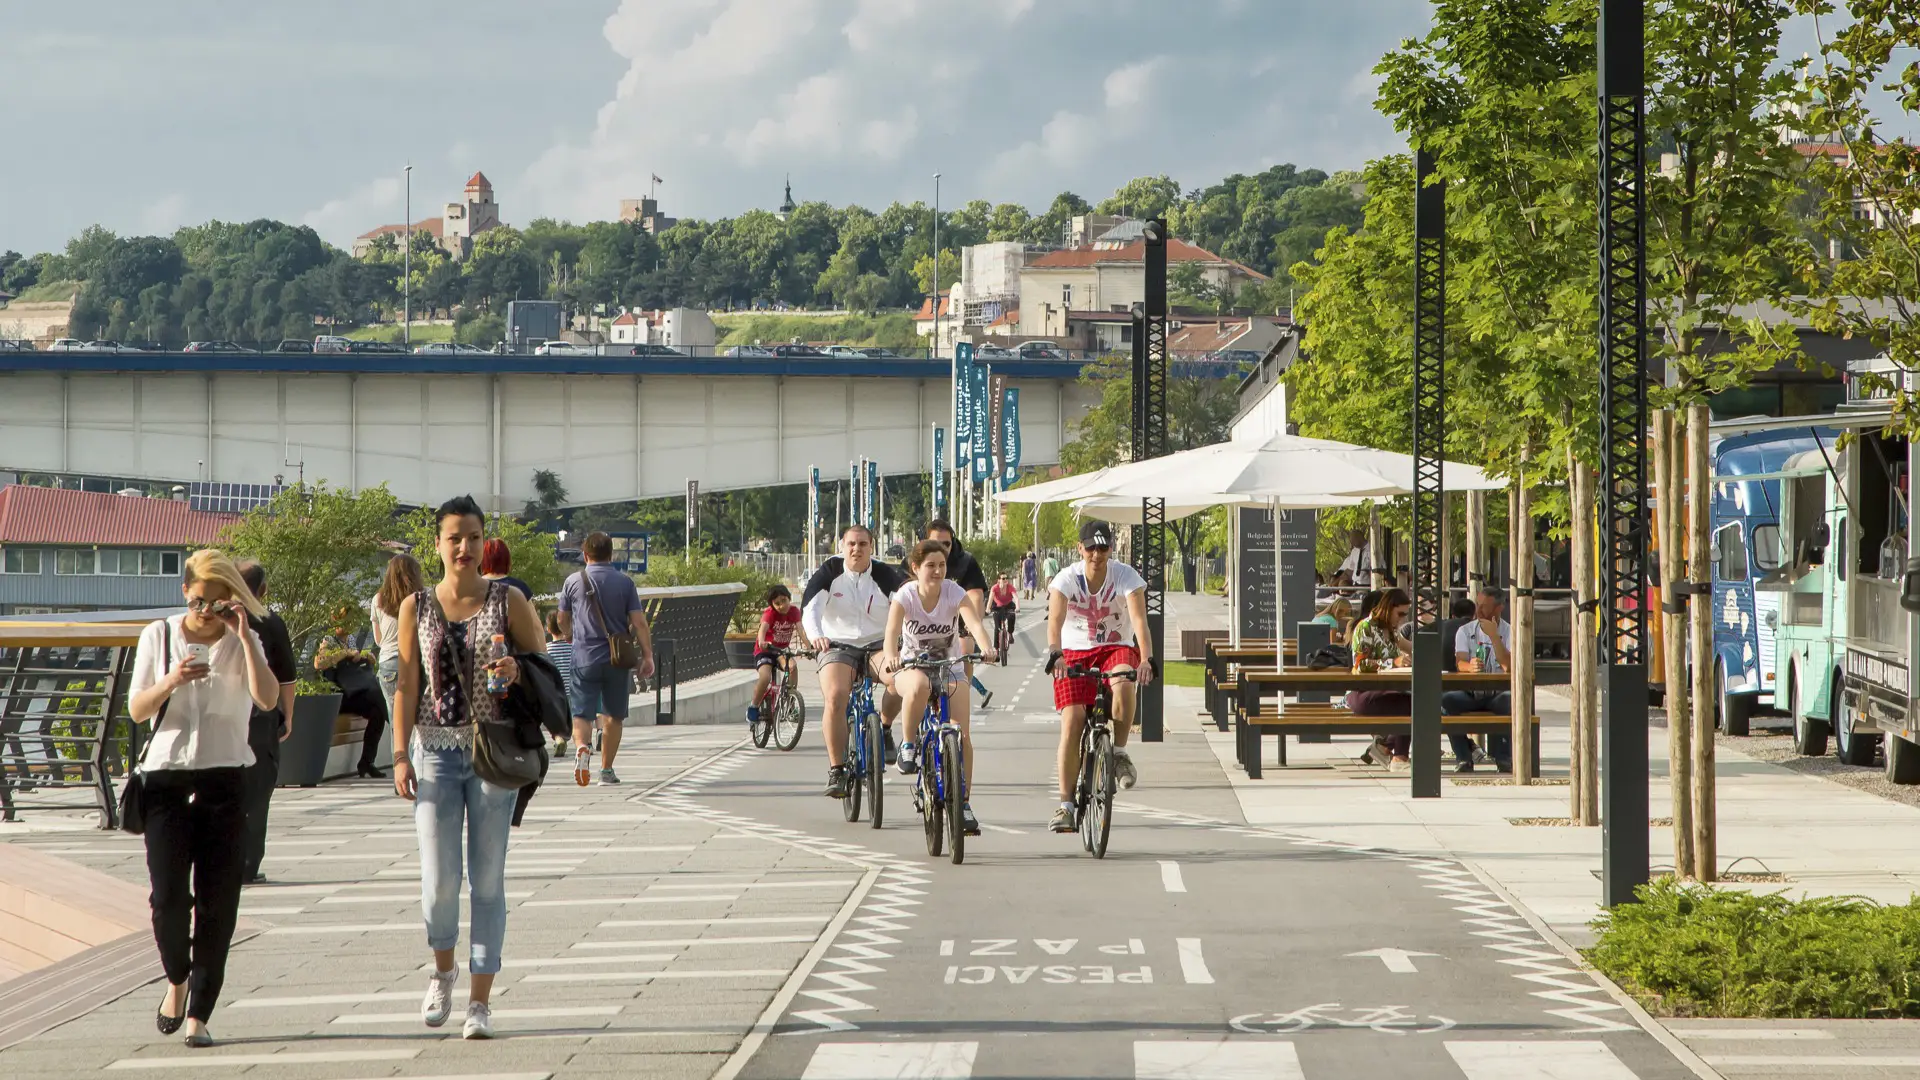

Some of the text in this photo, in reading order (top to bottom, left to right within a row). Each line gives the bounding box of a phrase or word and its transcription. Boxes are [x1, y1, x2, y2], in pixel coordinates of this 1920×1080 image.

[974, 398, 983, 453] Belgrade
[1247, 532, 1274, 540] Belgrade
[905, 616, 957, 635] Meow!
[939, 938, 1145, 956] PAZI
[943, 965, 1153, 984] PESACI
